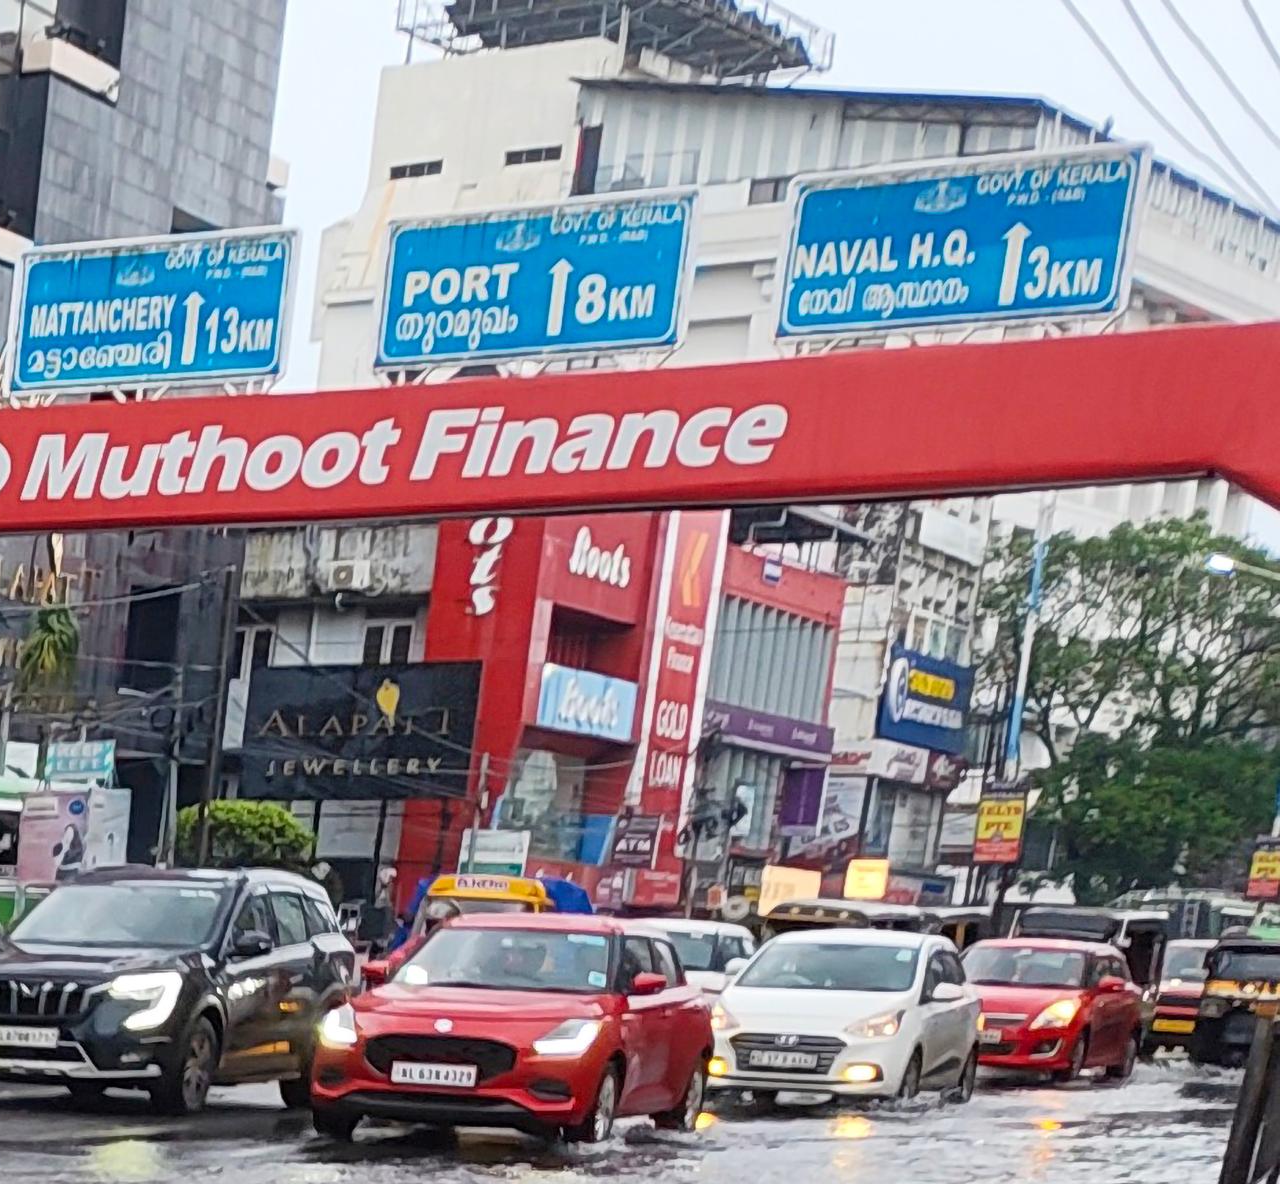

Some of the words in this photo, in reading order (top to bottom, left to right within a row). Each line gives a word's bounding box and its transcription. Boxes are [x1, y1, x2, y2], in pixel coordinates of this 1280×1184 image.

[1030, 167, 1054, 190] OF
[1057, 161, 1127, 188] KERALA
[596, 207, 617, 231] OF
[620, 205, 682, 229] KERALA
[206, 244, 226, 267] OF
[228, 243, 282, 267] KERALA
[794, 236, 898, 279] NAVAL
[908, 228, 976, 270] H.Q.
[402, 262, 520, 307] PORT
[29, 294, 177, 338] MATTANCHERY
[395, 304, 519, 355] തുറമുഖം
[27, 330, 173, 380] മട്ടാഞ്ചേരി
[20, 418, 402, 501] Muthoot
[409, 403, 789, 481] Finance
[656, 699, 689, 740] GOLD
[265, 756, 442, 777] JEWELLERY
[648, 749, 683, 791] LOAN
[614, 837, 651, 853] ATM
